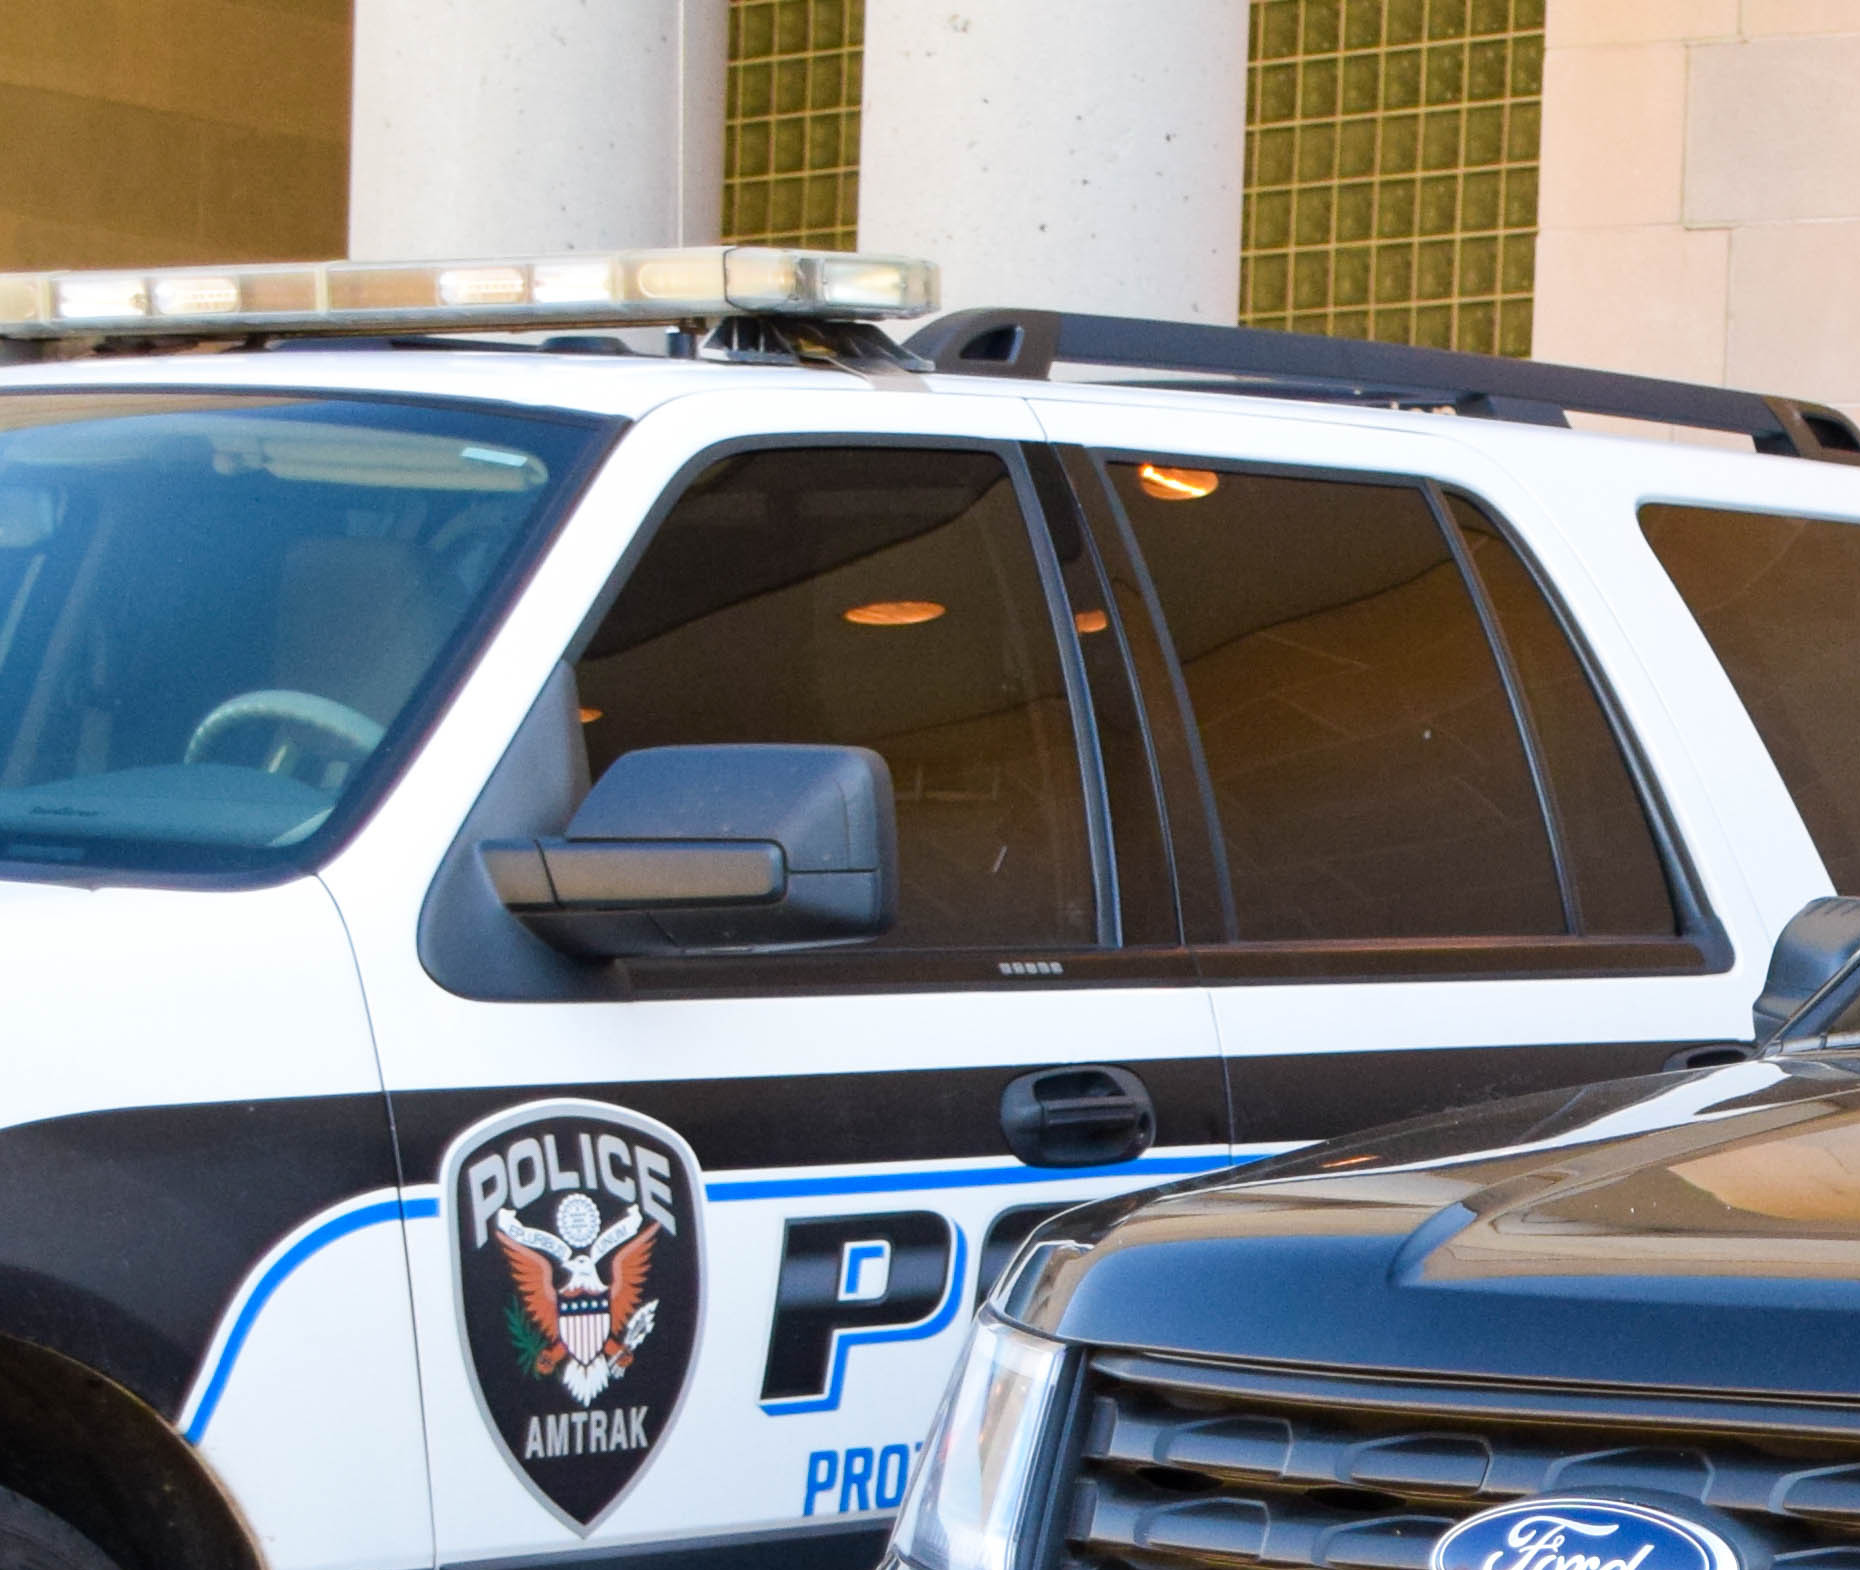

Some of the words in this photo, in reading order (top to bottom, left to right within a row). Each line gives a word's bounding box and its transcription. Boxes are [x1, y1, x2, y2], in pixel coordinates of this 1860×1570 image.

[469, 1133, 677, 1249] POLICE
[525, 1406, 648, 1460] AMTRAK
[802, 1441, 923, 1517] PRO
